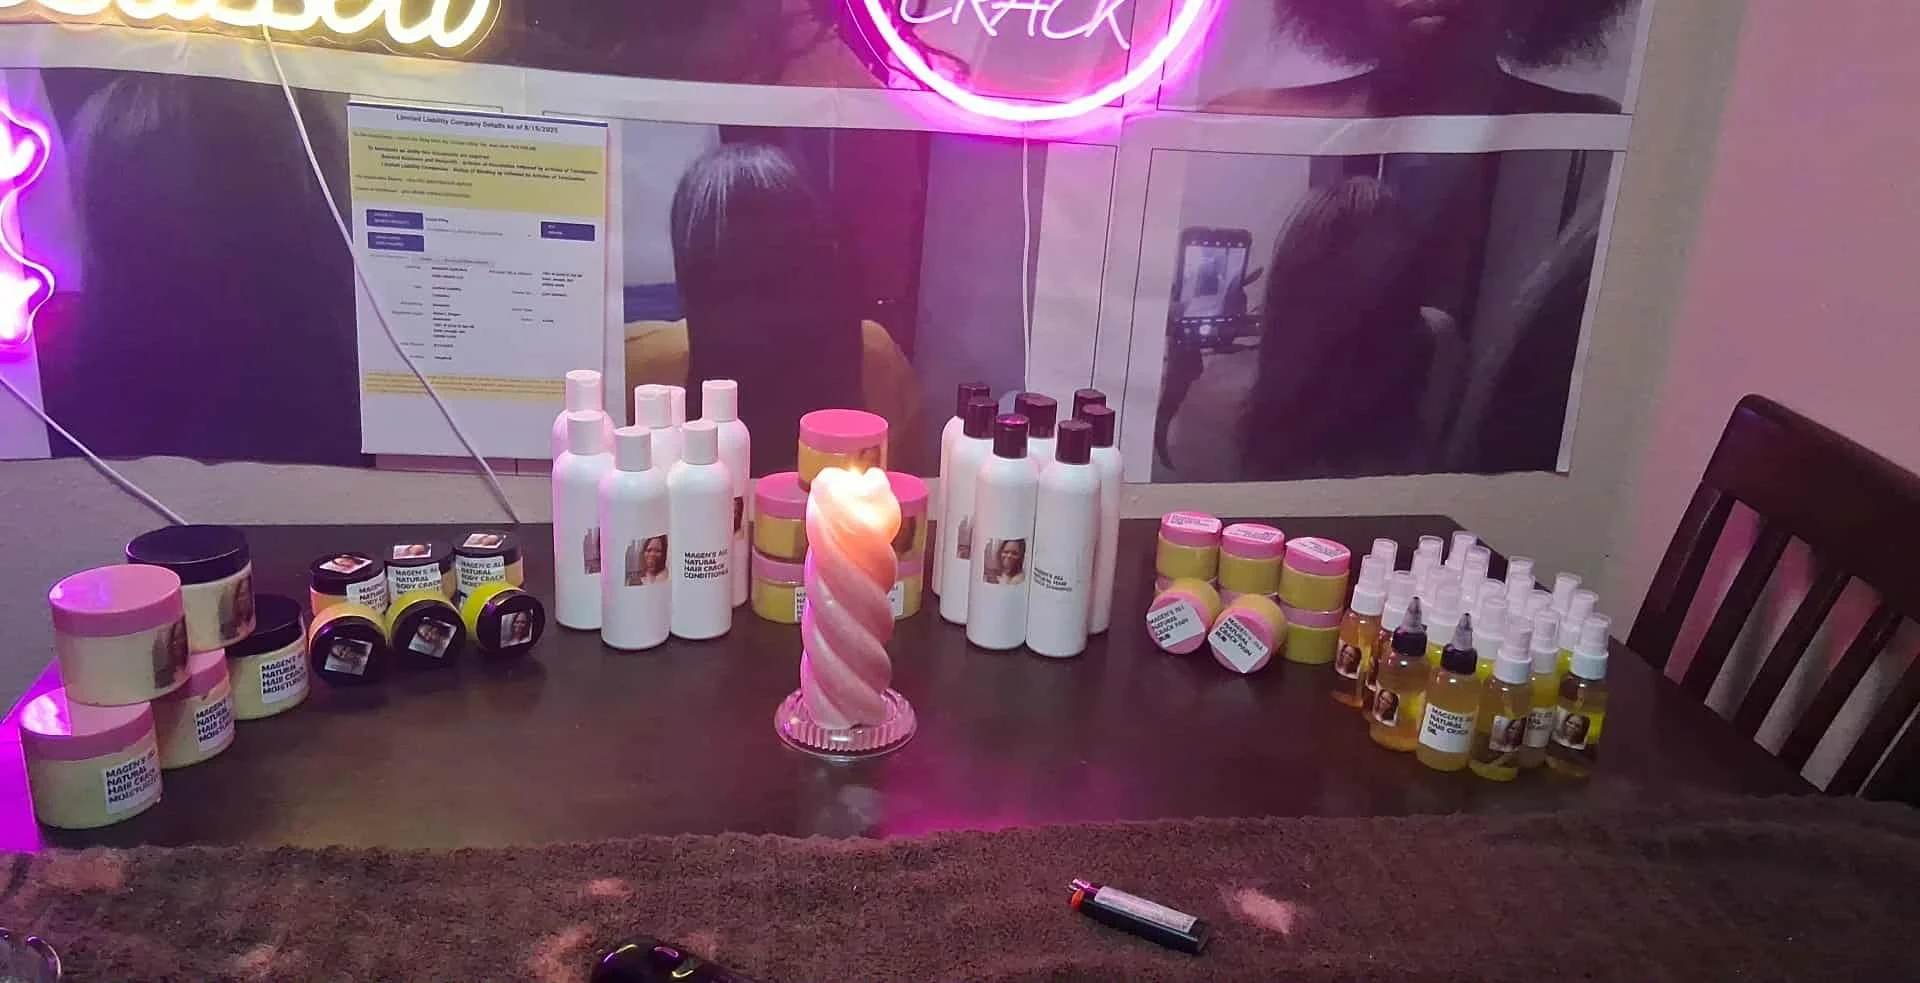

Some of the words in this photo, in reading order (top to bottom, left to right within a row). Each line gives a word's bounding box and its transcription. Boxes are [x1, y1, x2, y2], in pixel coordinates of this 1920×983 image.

[396, 113, 421, 122] Limited
[422, 114, 449, 125] Liability
[450, 119, 481, 128] Company
[482, 121, 505, 130] Details
[395, 575, 430, 583] NATURAL
[262, 676, 284, 687] HAIR
[107, 780, 133, 796] HAIR
